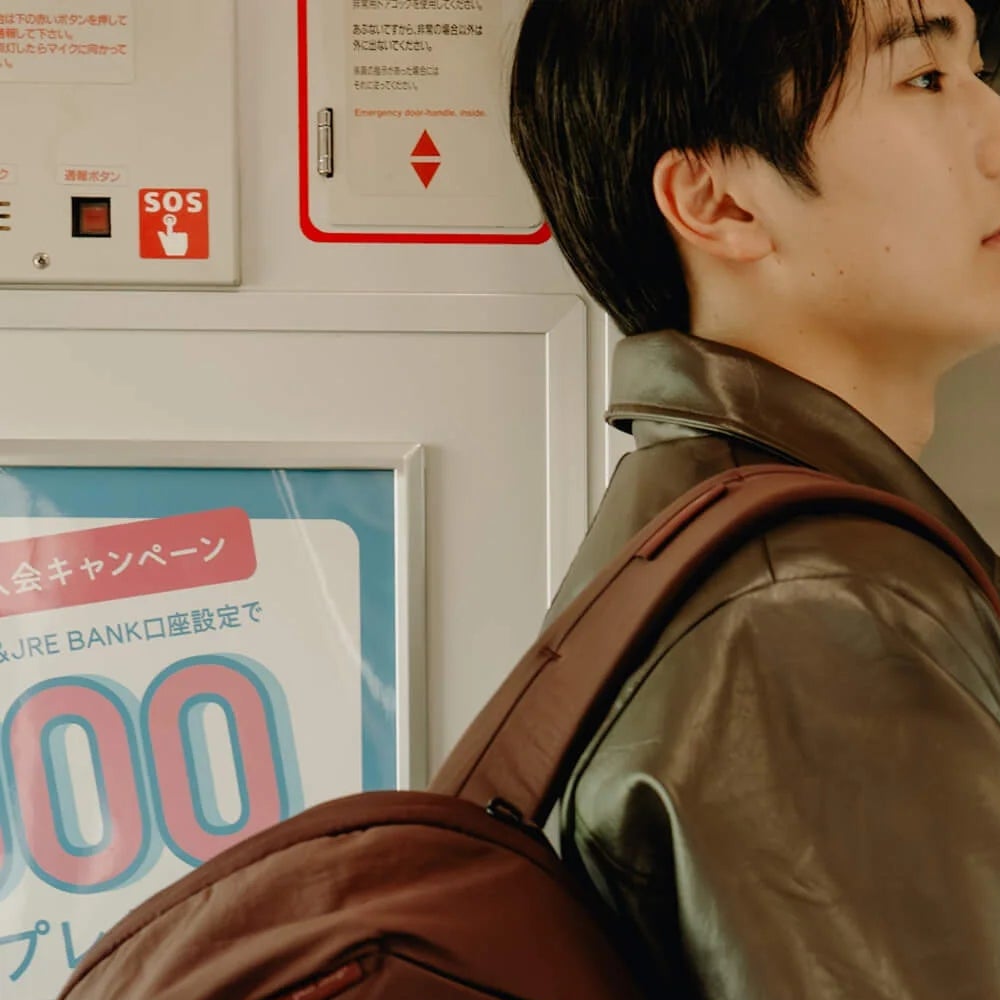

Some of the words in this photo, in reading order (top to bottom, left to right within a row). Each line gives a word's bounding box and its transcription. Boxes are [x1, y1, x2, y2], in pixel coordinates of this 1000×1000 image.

[353, 40, 432, 51] 外に出ないでください。
[354, 109, 401, 118] Emergency
[64, 169, 121, 182] 通報ボタン
[143, 191, 203, 213] SOS
